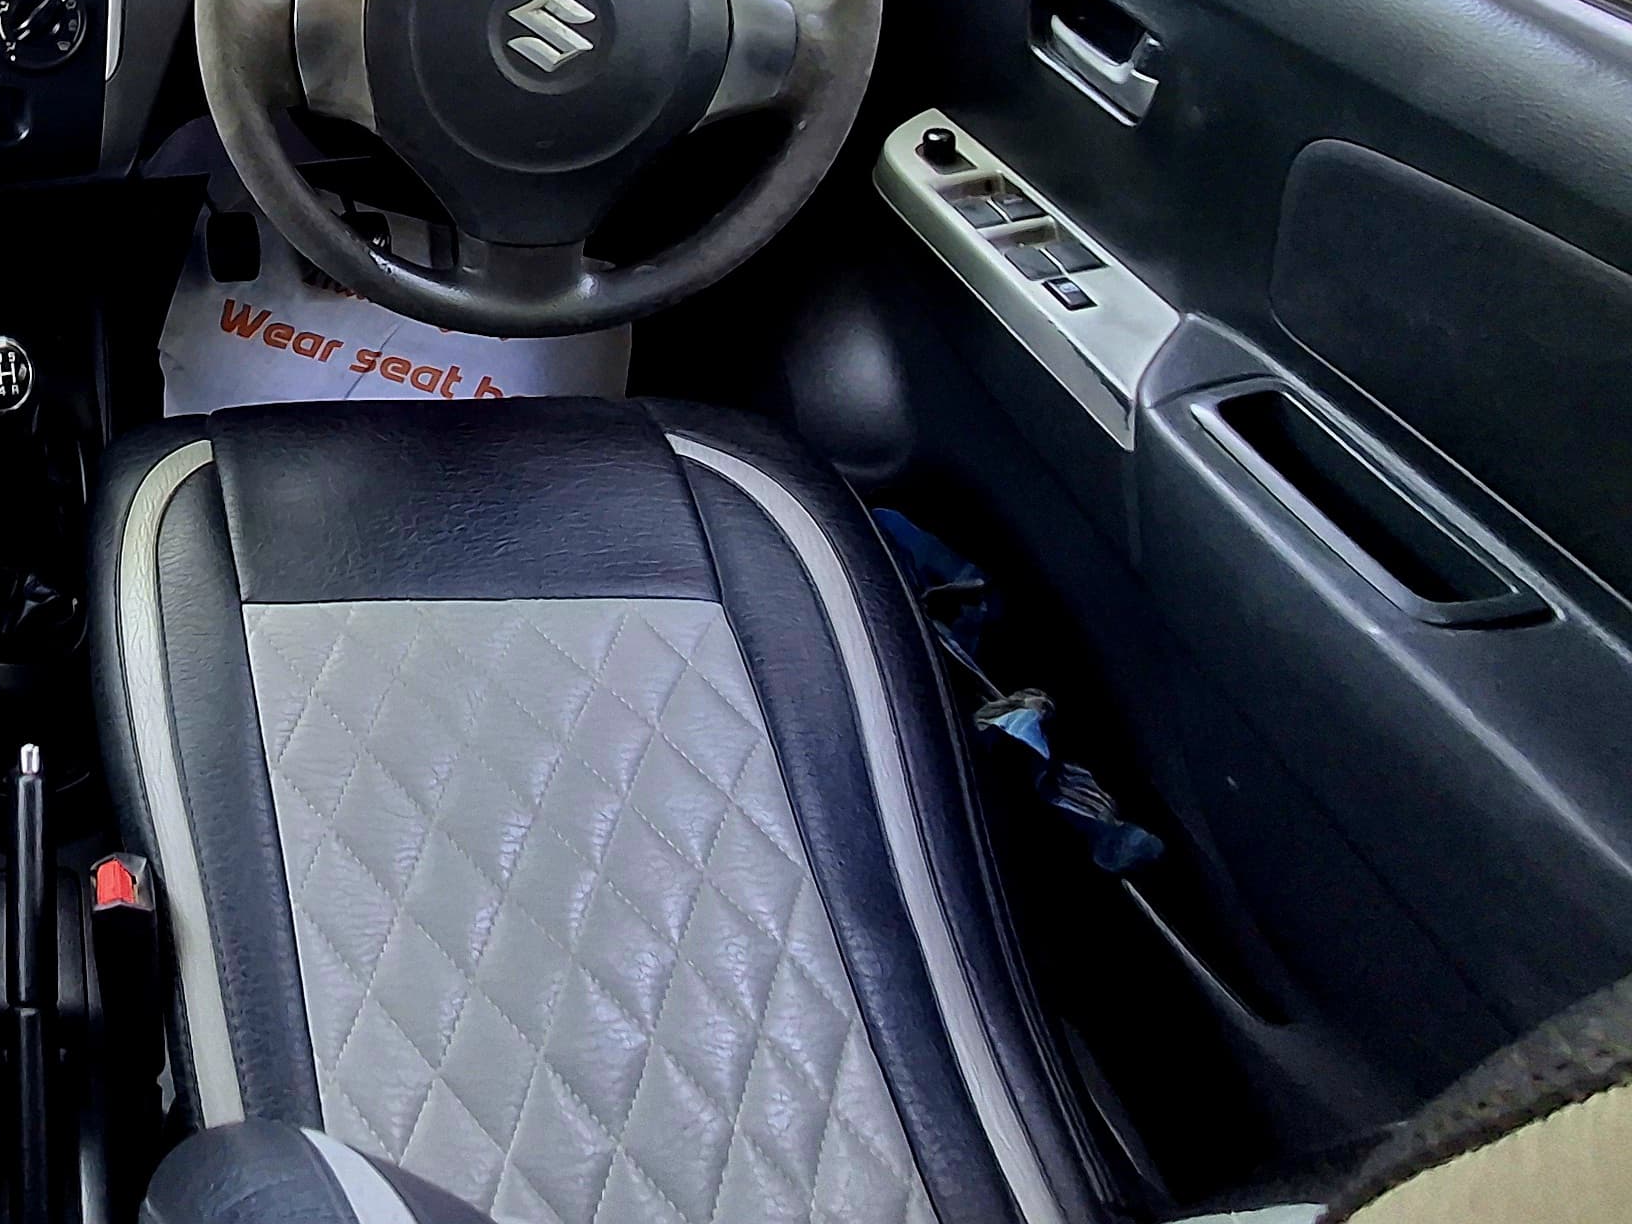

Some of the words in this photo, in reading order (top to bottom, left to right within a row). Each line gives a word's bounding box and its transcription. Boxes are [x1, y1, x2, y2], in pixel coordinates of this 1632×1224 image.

[219, 298, 344, 362] Wear
[350, 347, 464, 399] seat
[8, 352, 16, 362] 5
[11, 384, 19, 395] R
